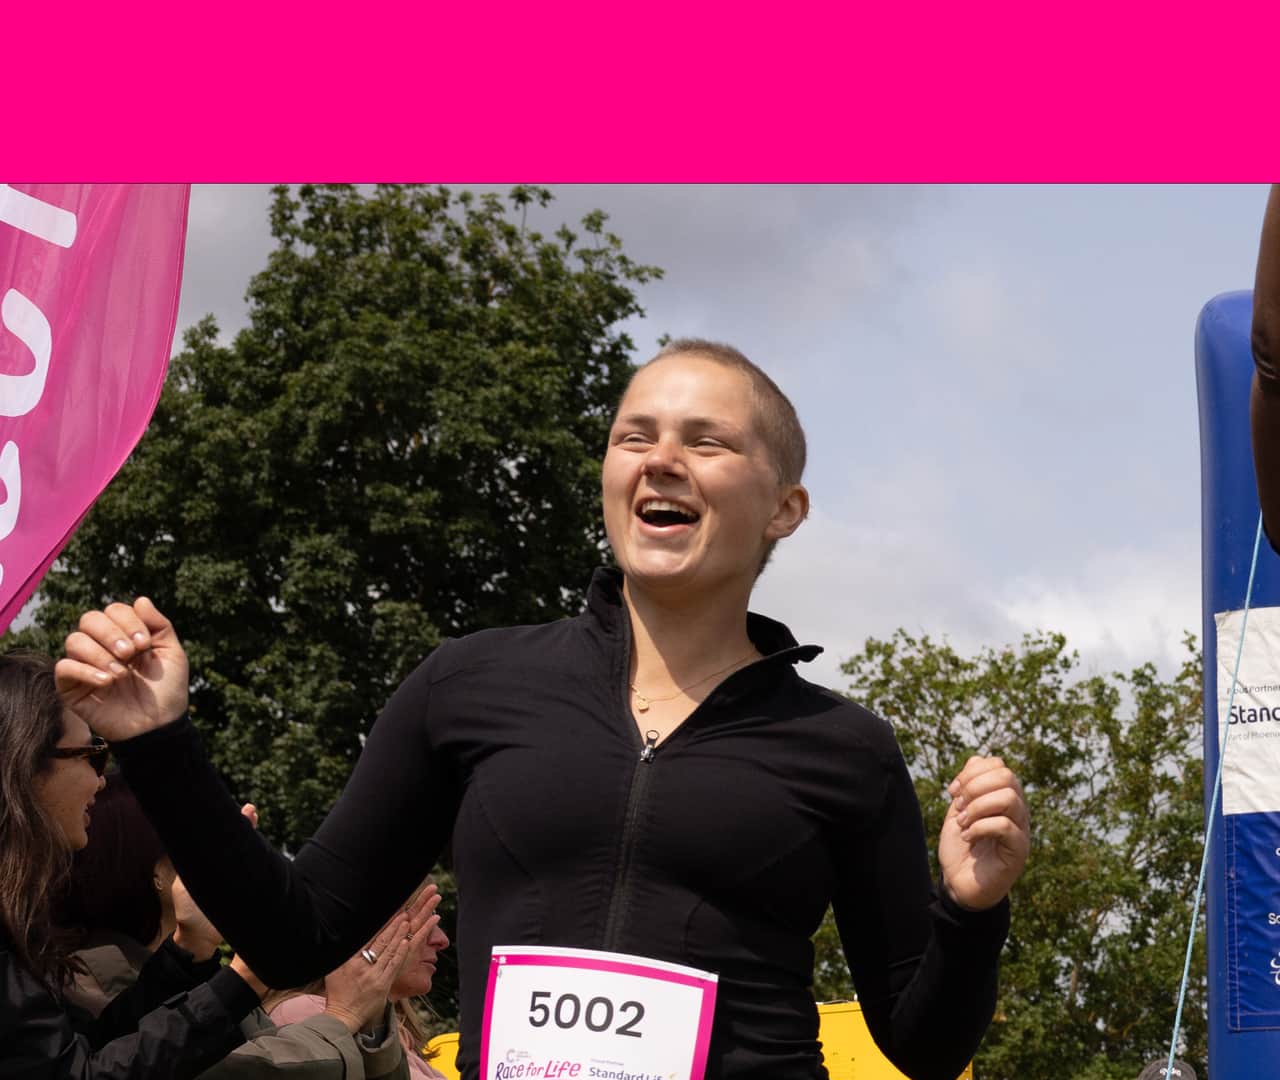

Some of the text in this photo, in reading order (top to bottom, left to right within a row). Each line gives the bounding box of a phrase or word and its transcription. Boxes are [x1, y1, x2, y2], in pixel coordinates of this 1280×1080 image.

[529, 991, 645, 1038] 5002
[526, 1062, 544, 1077] for
[544, 1060, 581, 1078] Life
